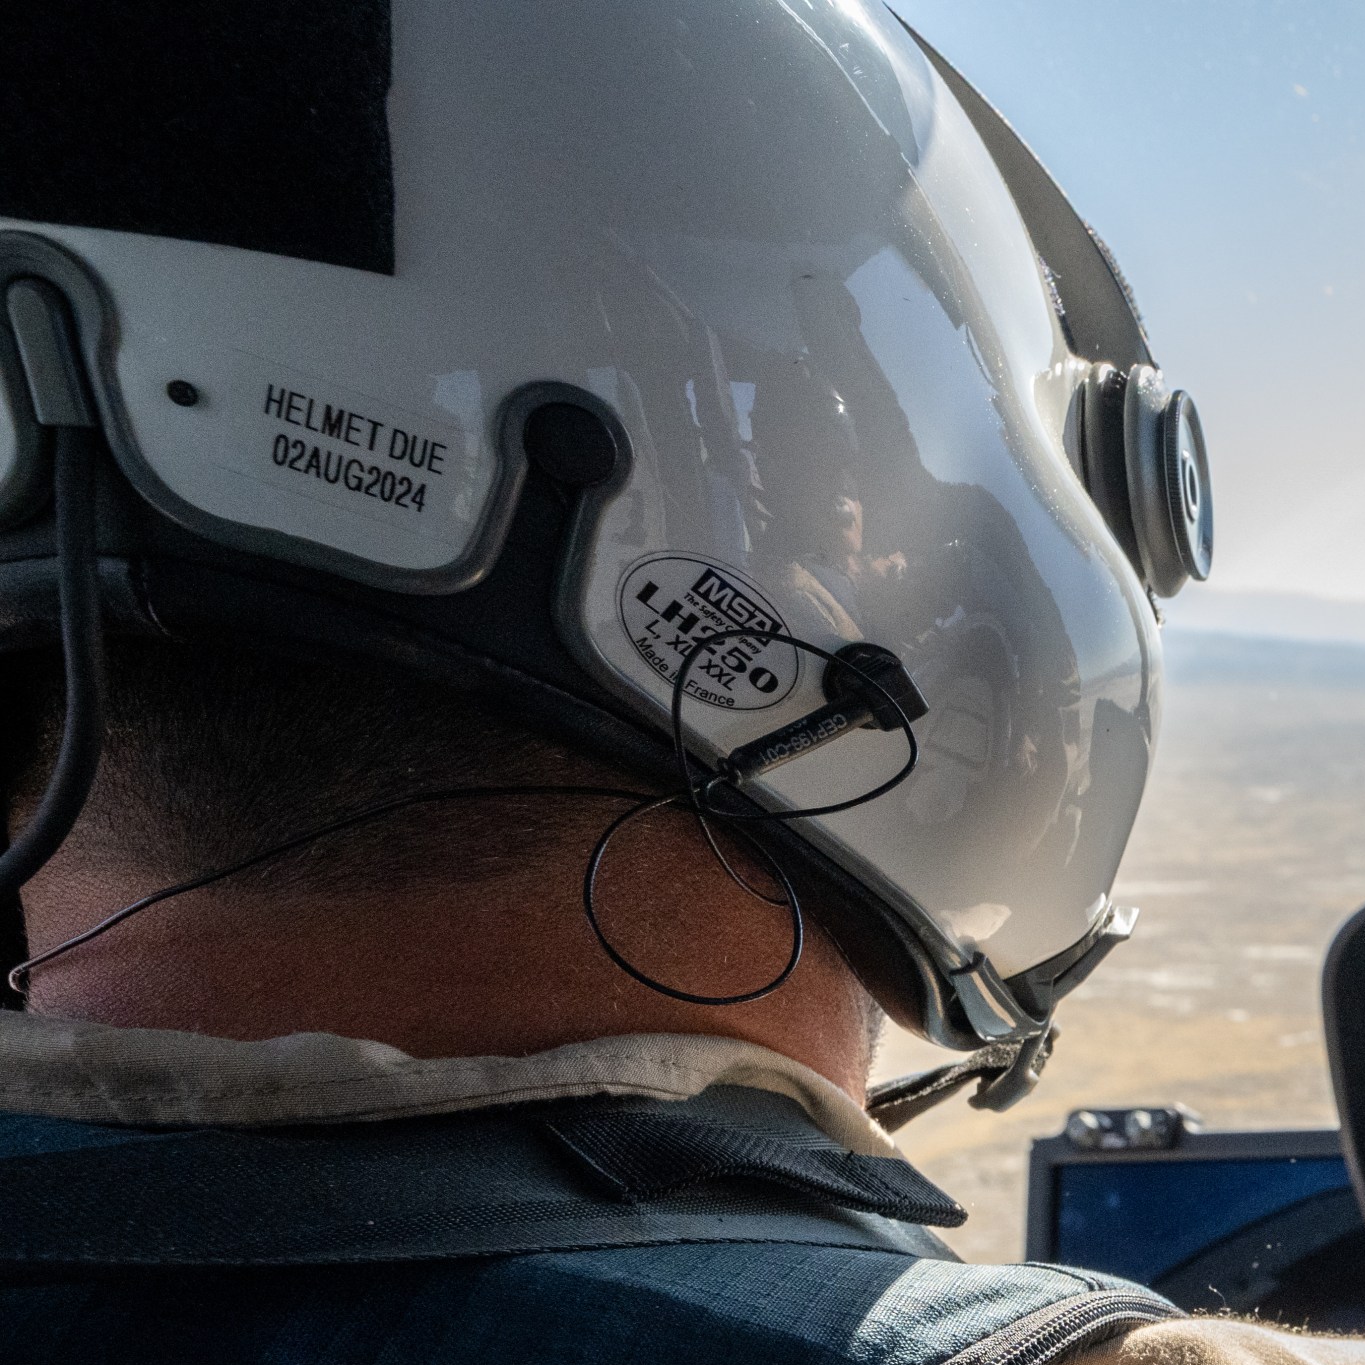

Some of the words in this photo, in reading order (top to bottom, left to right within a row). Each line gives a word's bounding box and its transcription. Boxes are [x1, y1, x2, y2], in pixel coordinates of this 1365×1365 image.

[264, 383, 385, 451] HELMET
[388, 427, 448, 475] DUE
[272, 433, 427, 513] 02AUG2024
[683, 591, 700, 607] The
[699, 604, 726, 627] Safety
[696, 575, 774, 642] MSA
[637, 636, 669, 673] Made
[684, 679, 735, 707] France
[697, 657, 737, 692] XXL
